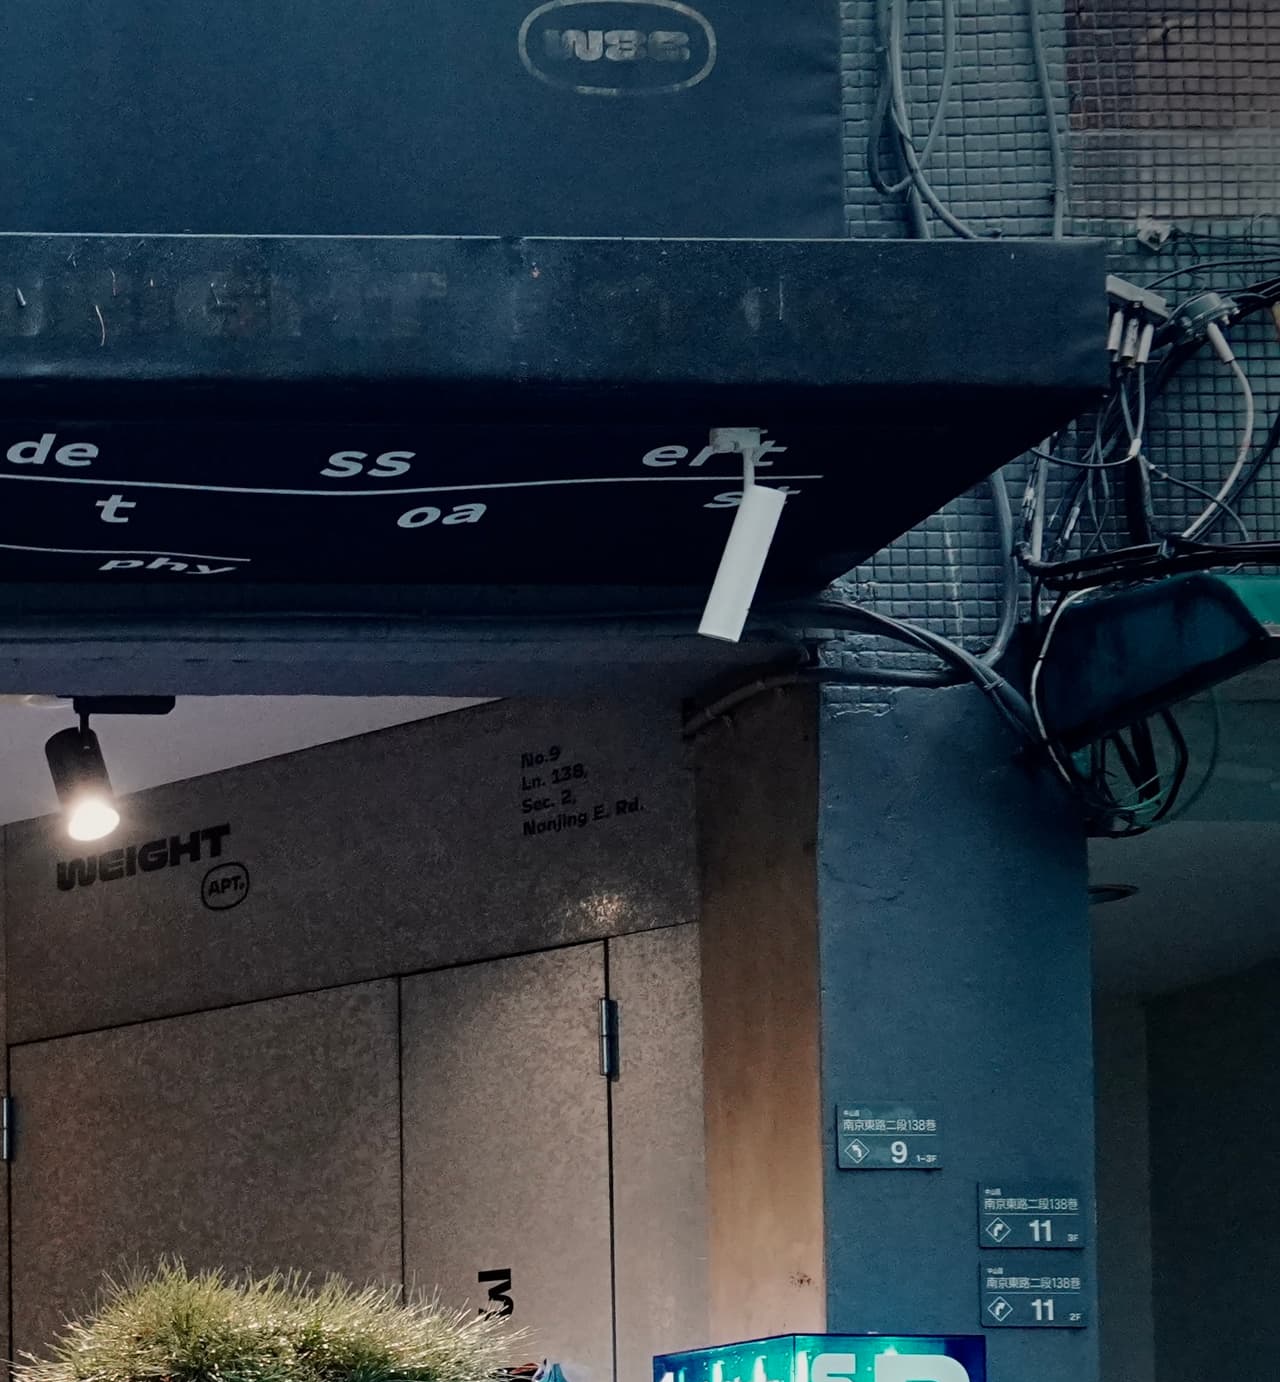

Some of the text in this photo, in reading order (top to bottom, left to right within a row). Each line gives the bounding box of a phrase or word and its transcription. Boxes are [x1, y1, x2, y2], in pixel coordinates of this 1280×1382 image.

[6, 433, 100, 467] de
[320, 449, 415, 478] ss
[95, 494, 137, 523] t
[396, 503, 487, 529] oa
[98, 557, 236, 575] phy
[523, 812, 588, 835] Nanjing
[56, 823, 231, 891] WEIGHT
[890, 1141, 909, 1164] 9
[1029, 1219, 1079, 1242] 11 3F
[1031, 1298, 1055, 1322] 11
